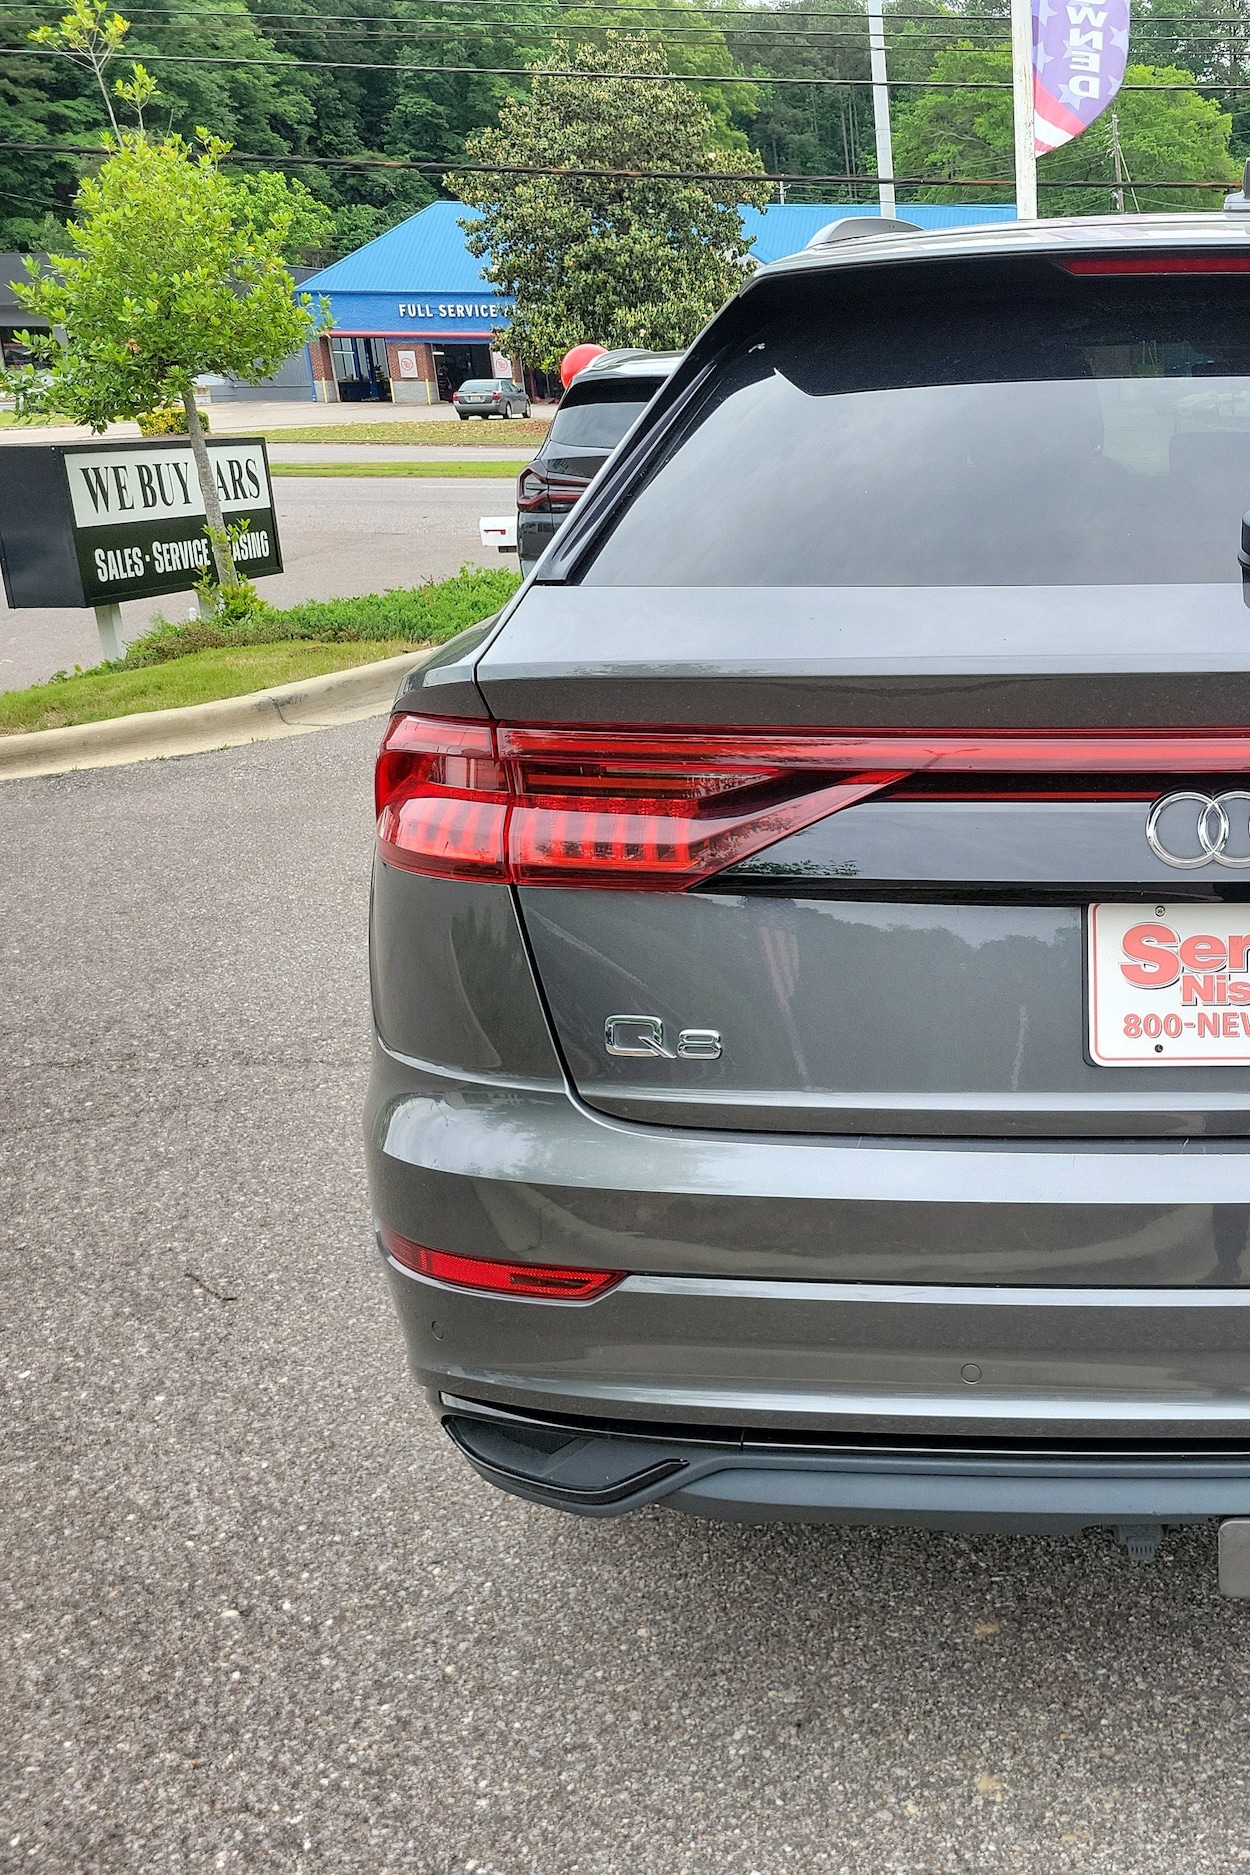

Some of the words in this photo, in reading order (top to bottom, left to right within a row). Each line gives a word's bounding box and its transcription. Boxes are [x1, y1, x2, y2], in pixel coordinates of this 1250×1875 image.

[398, 304, 433, 317] FULL
[439, 304, 498, 317] SERVICE
[79, 465, 134, 513] WE
[135, 462, 192, 508] BUY
[198, 458, 260, 501] ARS
[94, 547, 145, 582] SALES
[151, 538, 211, 574] SERVICE
[226, 530, 270, 562] ASING
[604, 1014, 723, 1060] Q8
